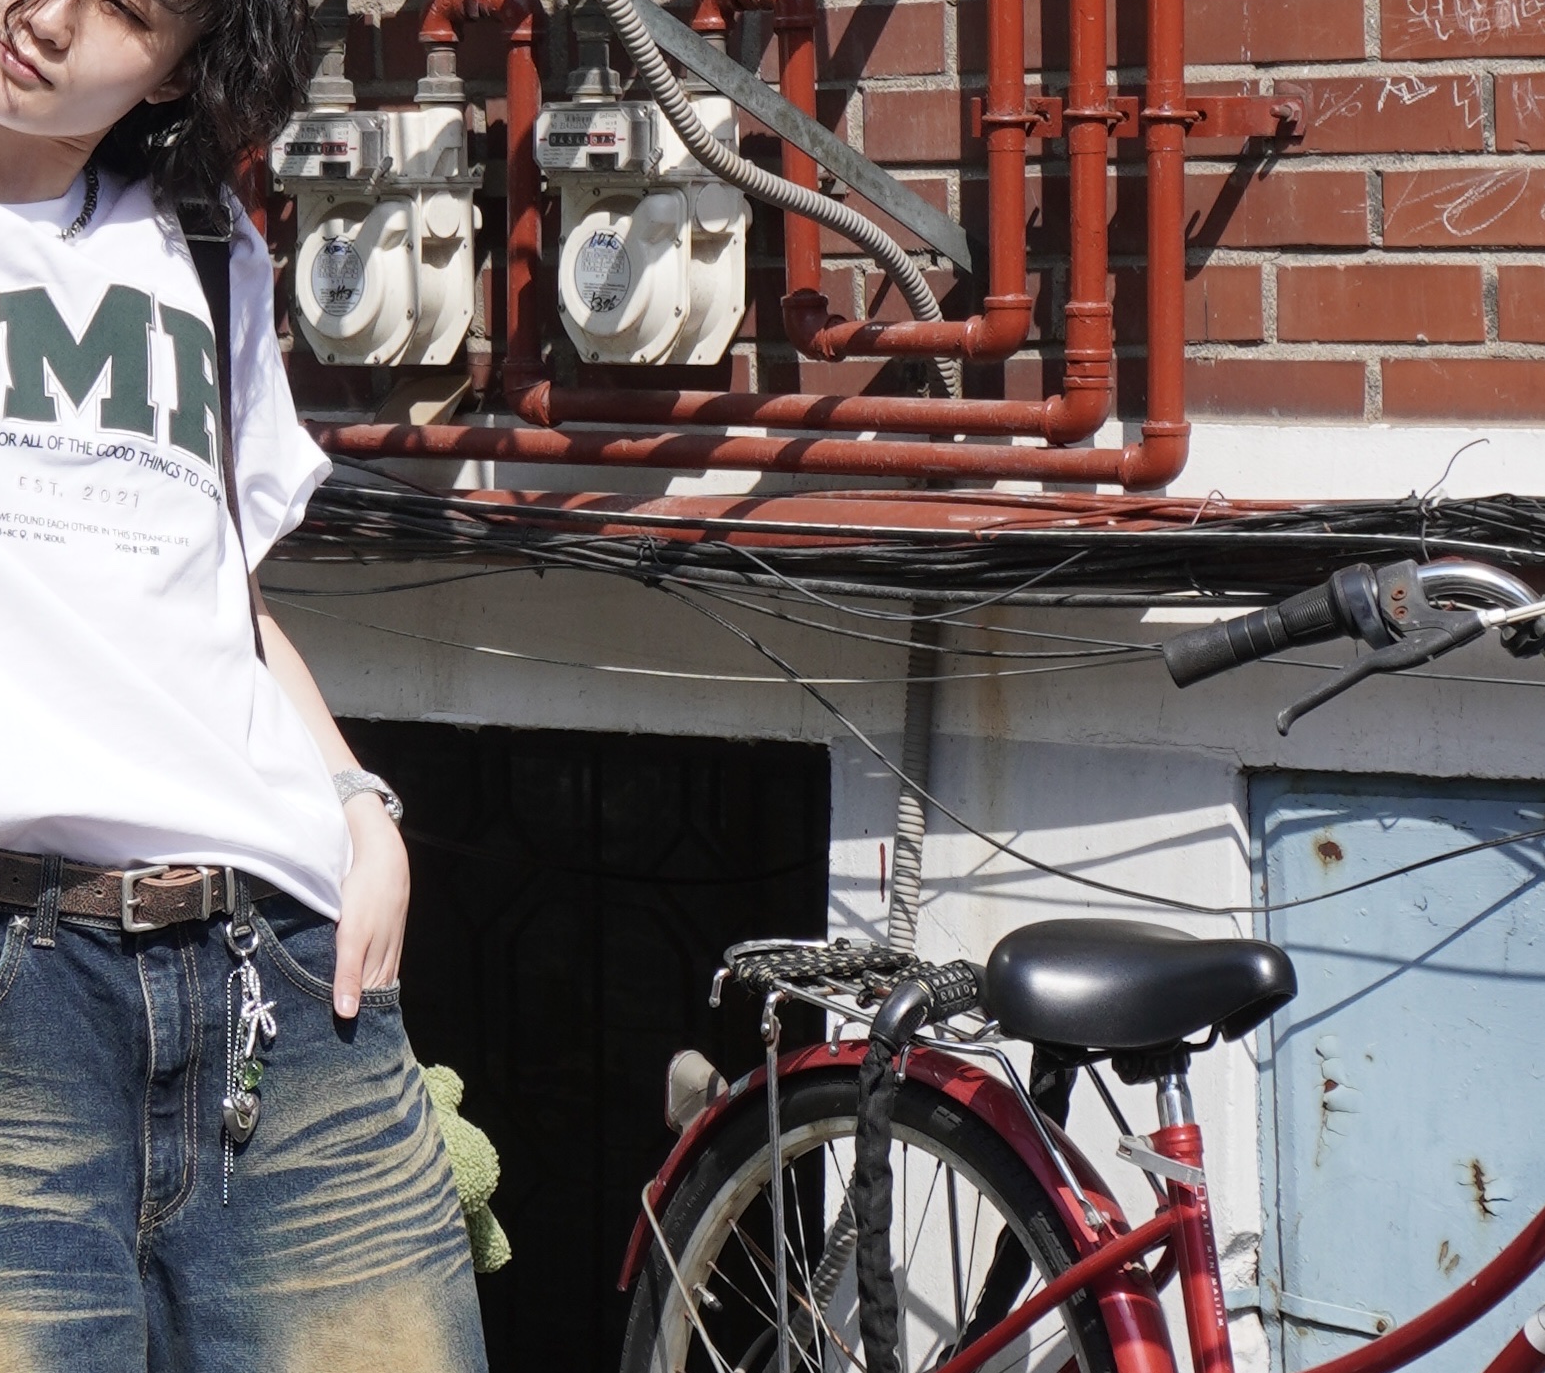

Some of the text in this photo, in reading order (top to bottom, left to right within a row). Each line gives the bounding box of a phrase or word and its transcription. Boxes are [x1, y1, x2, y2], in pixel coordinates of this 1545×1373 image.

[19, 434, 43, 448] ALL
[47, 435, 64, 451] OF
[68, 438, 93, 456] THE
[96, 443, 135, 462] GOOD
[138, 451, 182, 479] THINGS
[184, 468, 199, 487] TO
[82, 485, 141, 509] 2021
[13, 514, 45, 527] FOUND
[47, 519, 69, 531] EACH
[70, 521, 99, 535] OTHER
[101, 527, 110, 537] IN
[112, 529, 130, 541] THIS
[132, 532, 172, 545] STRANGE
[174, 536, 189, 548] LIFE
[43, 534, 66, 545] SEOUL
